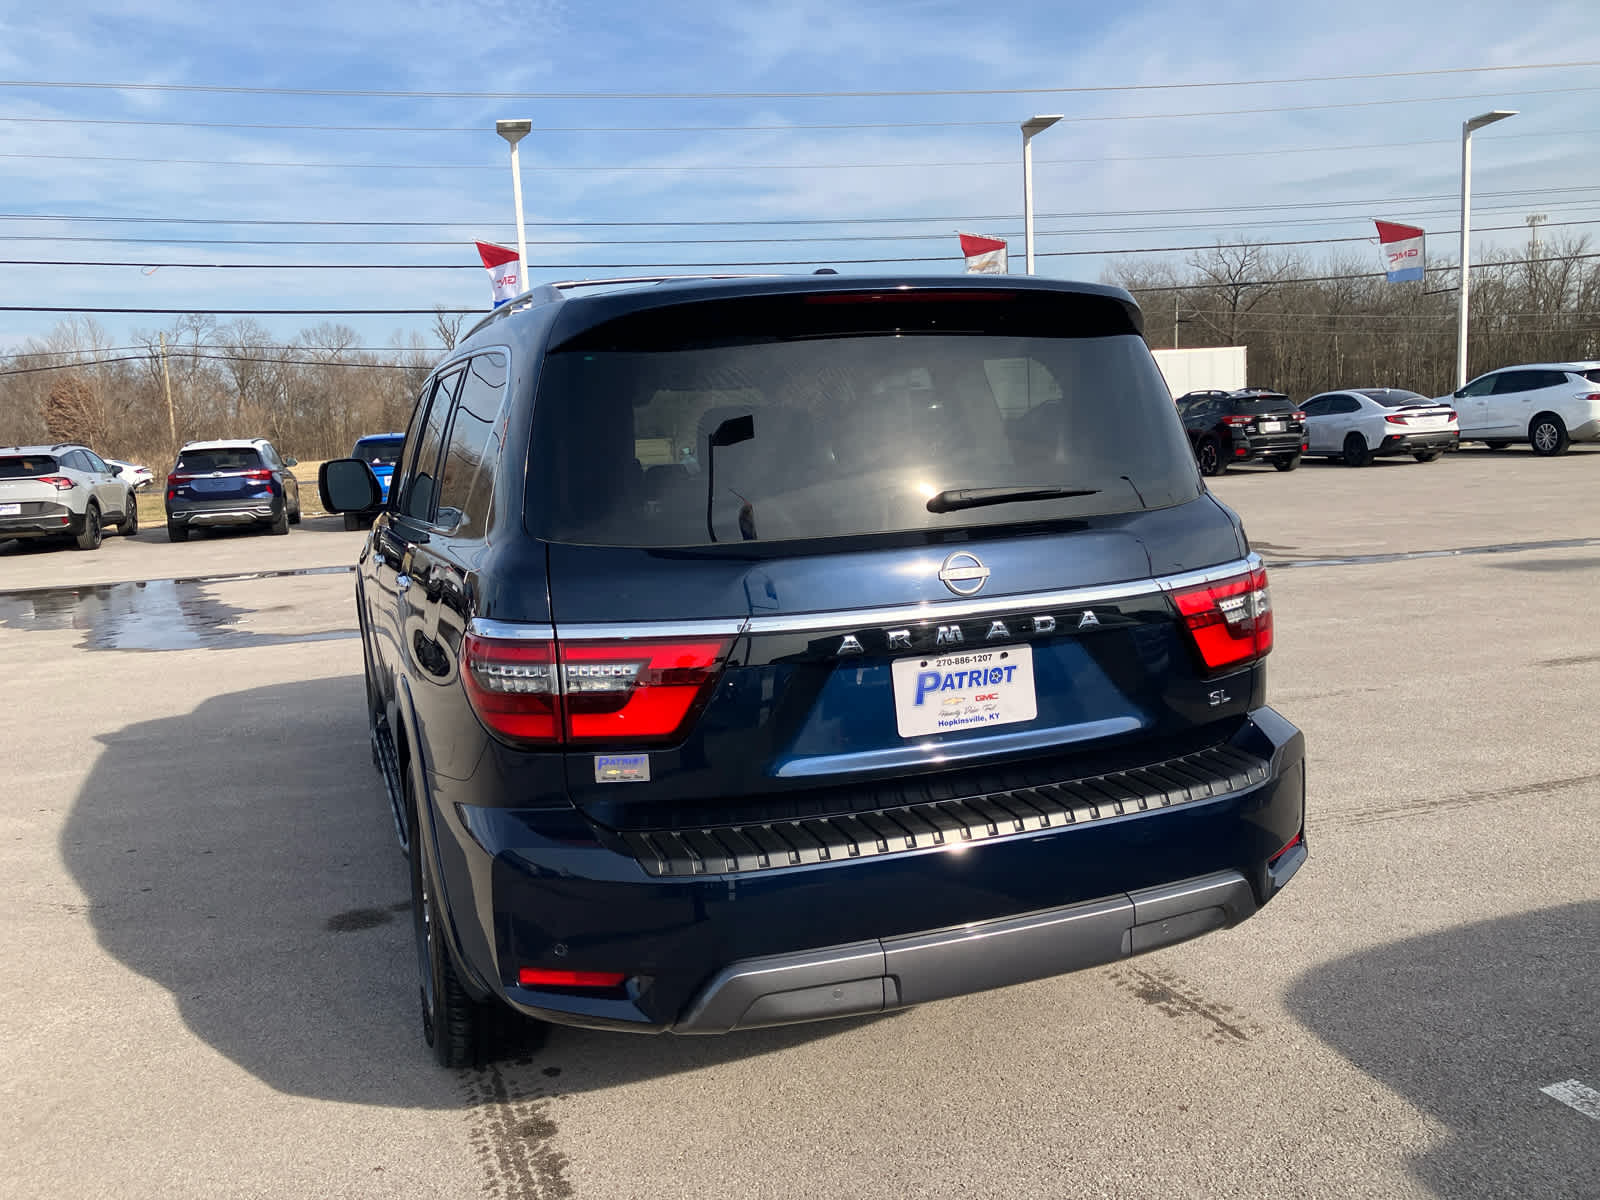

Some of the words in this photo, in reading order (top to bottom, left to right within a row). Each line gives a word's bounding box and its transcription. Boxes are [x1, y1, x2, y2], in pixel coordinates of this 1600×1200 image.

[836, 609, 1101, 655] ARMADA
[936, 653, 993, 667] 270-886-1207
[914, 665, 1017, 706] PATRIOT
[975, 693, 999, 702] GMC
[1209, 689, 1232, 706] SL
[937, 714, 988, 728] Hopkinsville,
[988, 712, 1000, 721] KY
